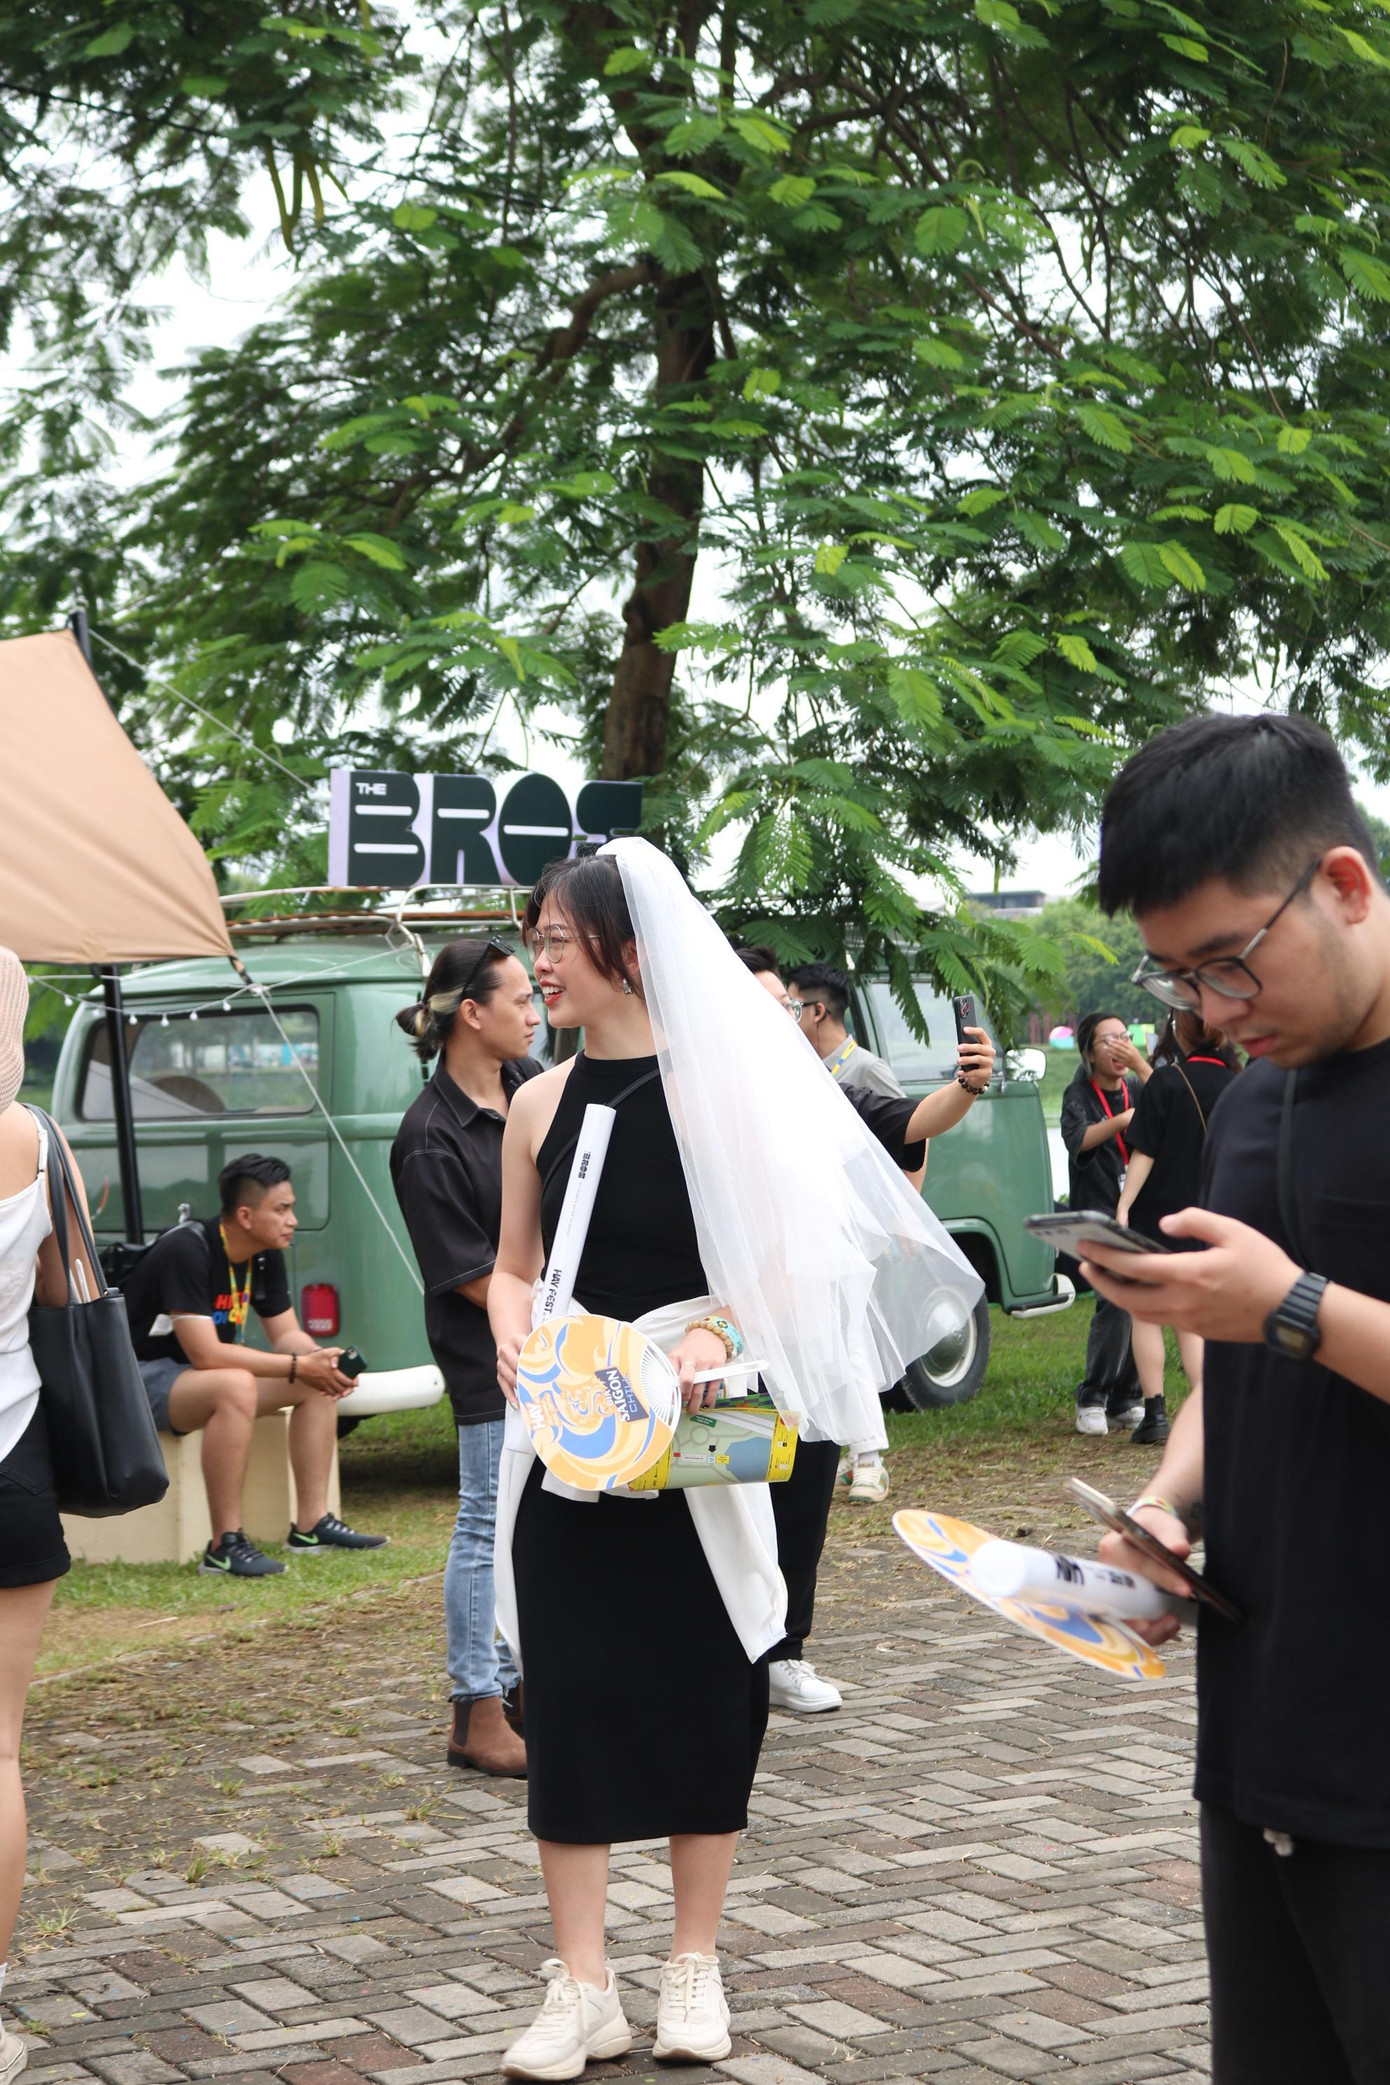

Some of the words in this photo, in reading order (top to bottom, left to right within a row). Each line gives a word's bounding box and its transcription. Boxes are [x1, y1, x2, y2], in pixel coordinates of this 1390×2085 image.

[355, 782, 388, 796] THE
[577, 1152, 592, 1180] BROS
[550, 1269, 562, 1289] HAY
[606, 1369, 631, 1422] SAIGON
[525, 1402, 547, 1430] HAY
